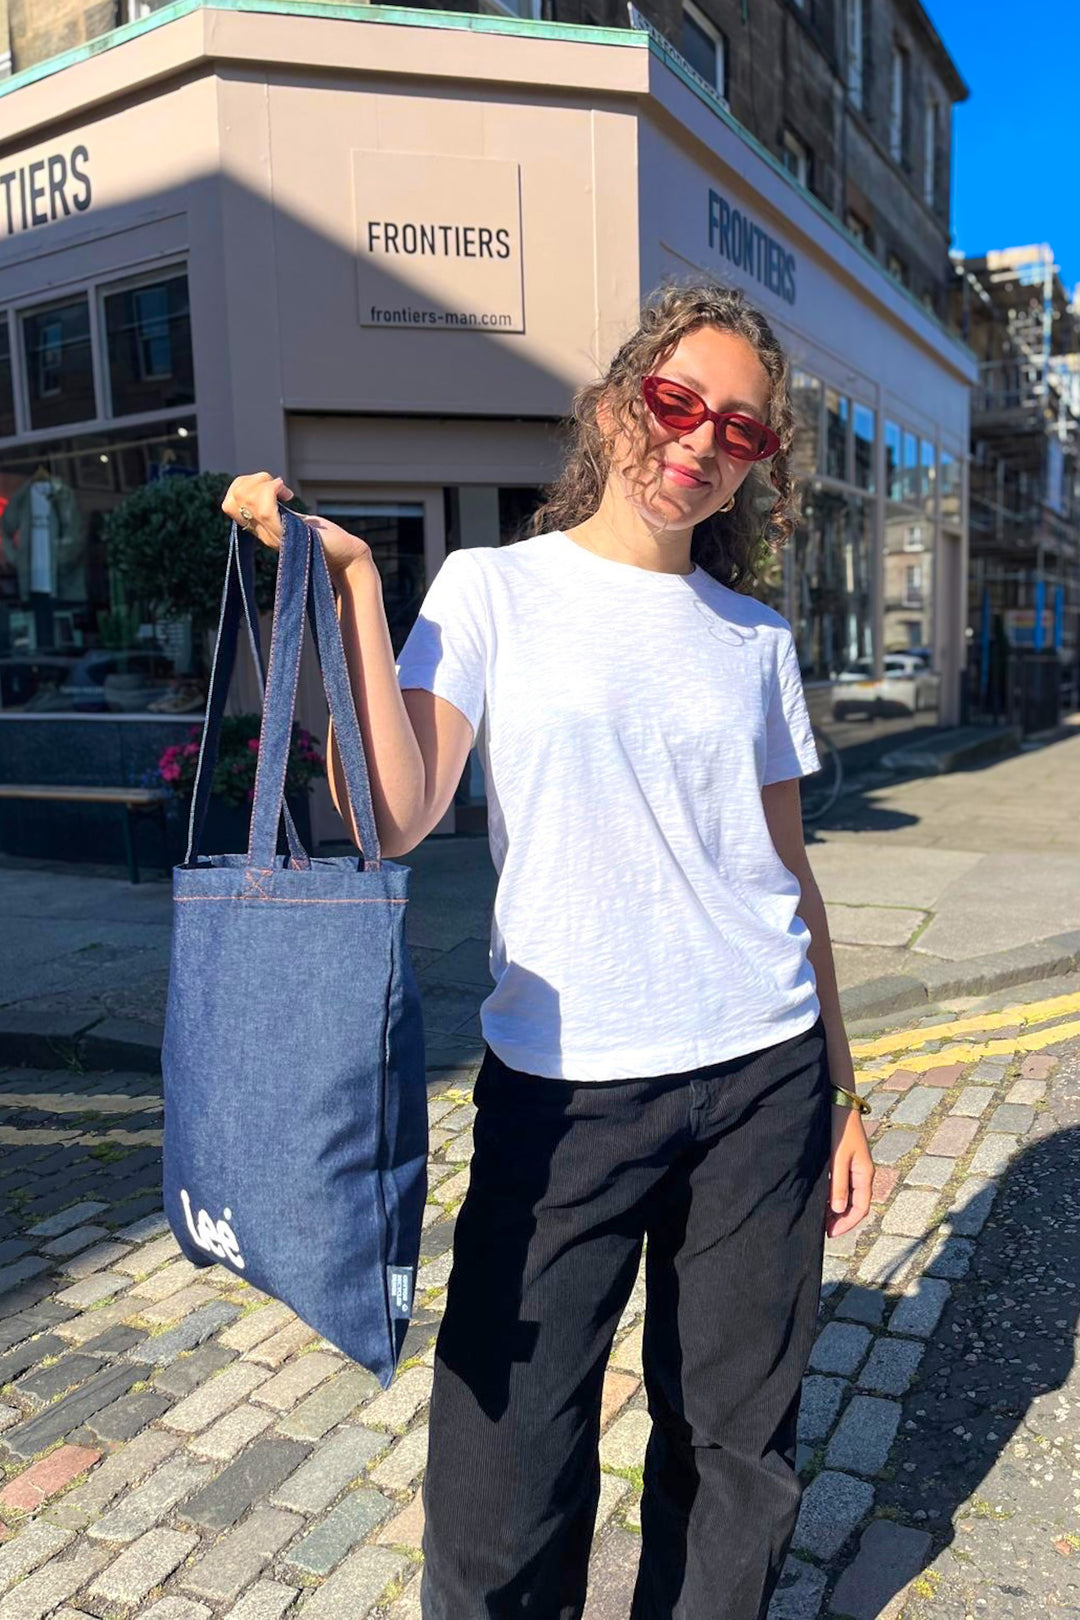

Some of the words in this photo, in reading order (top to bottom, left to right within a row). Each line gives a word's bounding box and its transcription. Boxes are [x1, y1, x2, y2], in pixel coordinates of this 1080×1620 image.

[0, 145, 91, 234] TIERS
[368, 222, 511, 259] FRONTIERS
[709, 188, 796, 306] FRONTIERS
[371, 306, 513, 327] frontiers-man.com
